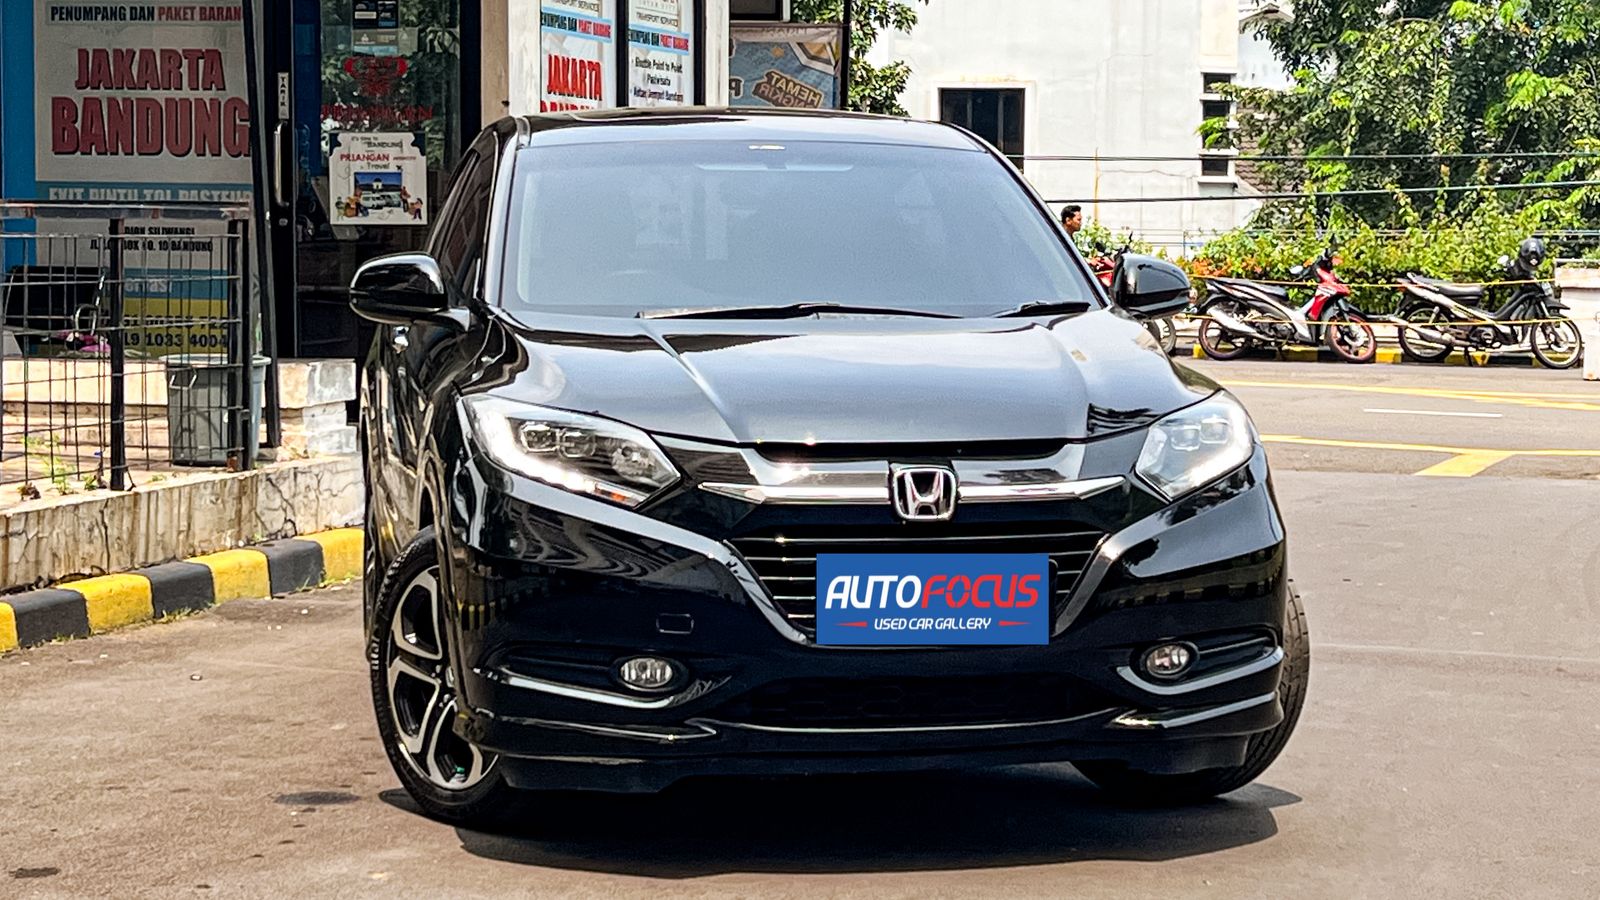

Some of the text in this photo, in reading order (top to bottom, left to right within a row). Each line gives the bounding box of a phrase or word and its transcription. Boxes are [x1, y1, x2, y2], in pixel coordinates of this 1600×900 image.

[51, 6, 242, 21] PENUMPANG DAN PAKET BARAN
[75, 48, 226, 91] JAKARTA
[547, 54, 602, 101] JAKARTA
[51, 97, 250, 158] BANDUNG
[340, 153, 389, 162] PRIANGAN
[366, 162, 390, 170] Travel
[825, 574, 1040, 609] AUTOFOCUS
[874, 618, 991, 630] USED CAR GALLERY
